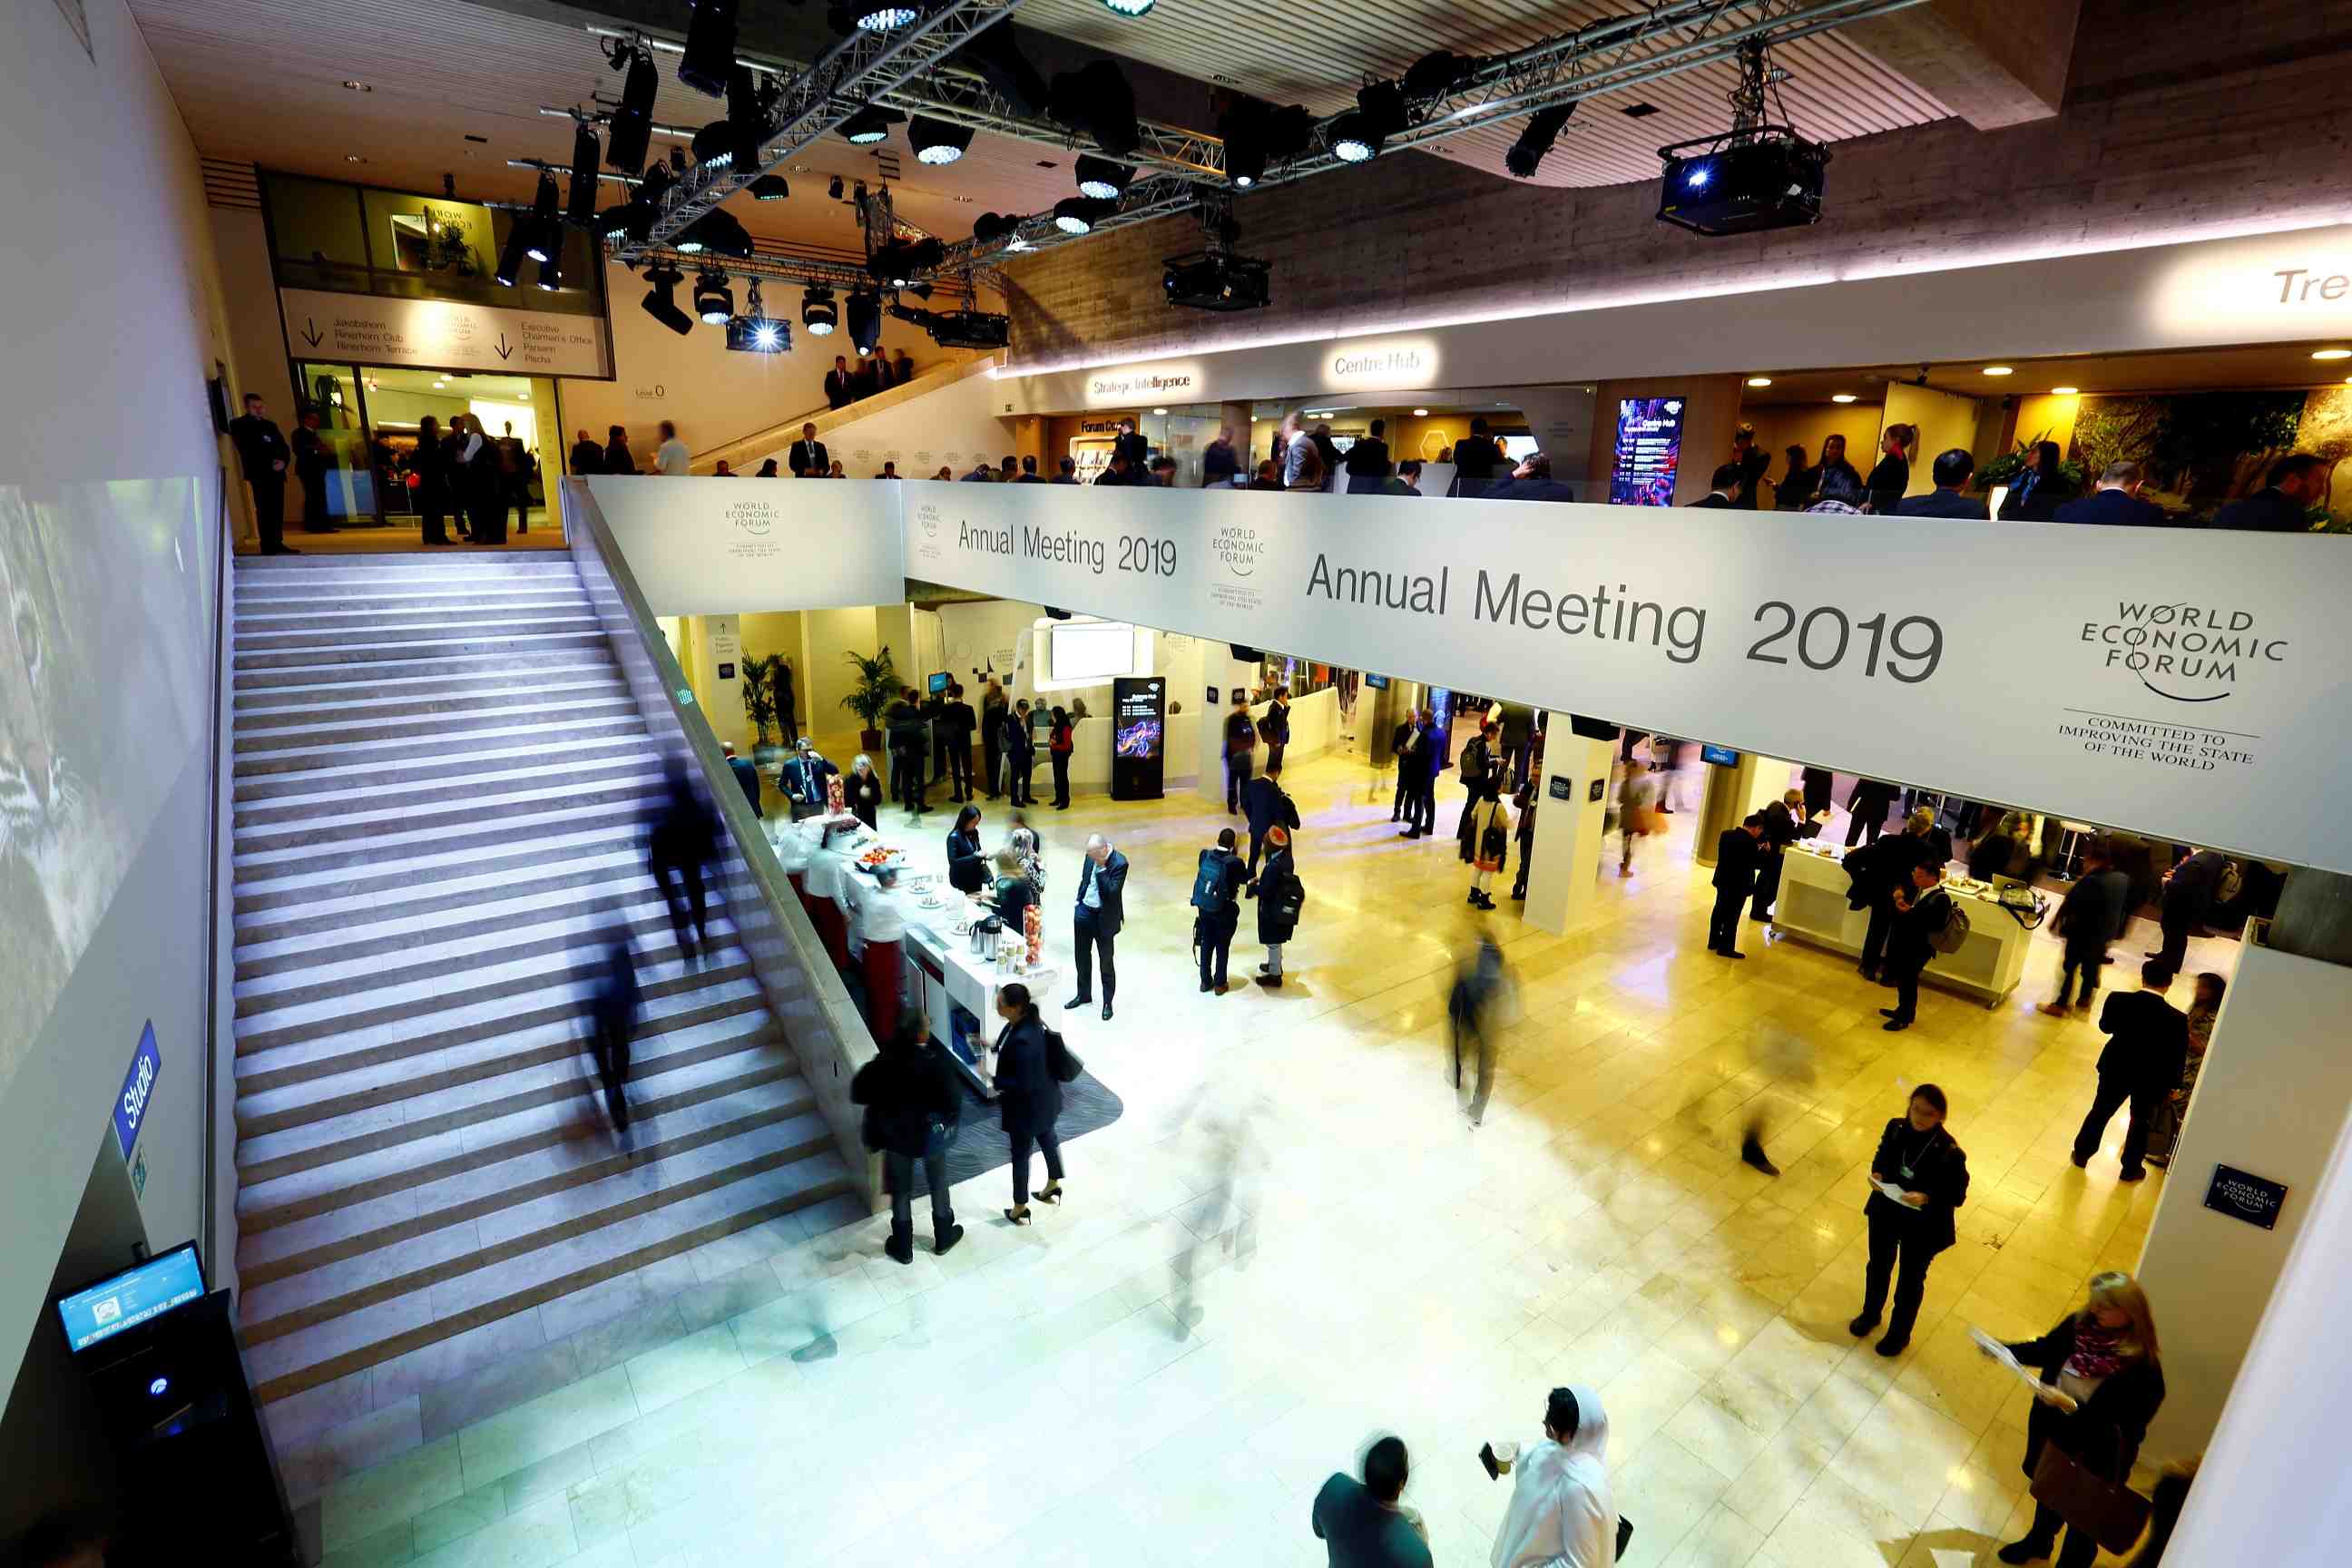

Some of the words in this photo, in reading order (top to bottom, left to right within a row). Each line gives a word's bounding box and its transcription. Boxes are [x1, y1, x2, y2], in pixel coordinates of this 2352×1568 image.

[2274, 269, 2350, 303] Tre
[521, 322, 559, 333] Executive
[569, 336, 593, 345] Office
[1335, 357, 1383, 375] Centre
[1387, 349, 1420, 371] Hub
[1135, 375, 1191, 391] Intelligence
[1082, 420, 1104, 433] Forum
[725, 510, 779, 518] ECONOMIC
[735, 518, 769, 527] FORUM
[1212, 538, 1264, 554] ECONOMIC
[1220, 527, 1256, 539] WORLD
[959, 520, 1014, 555] Annual
[1024, 525, 1104, 574] Meeting
[1118, 535, 1177, 576] 2019
[1220, 551, 1254, 565] FORUM
[1307, 553, 1449, 615] Annual
[1474, 569, 1707, 664] Meeting
[1747, 601, 1945, 684] 2019
[2119, 602, 2254, 632] WORLD
[2081, 622, 2288, 662] ECONOMIC
[2105, 649, 2236, 682] FORUM
[2088, 717, 2196, 742] COMMITTED
[2200, 733, 2226, 746] TO
[2058, 725, 2153, 750] IMPROVING
[2158, 740, 2194, 756] THE
[2199, 747, 2254, 765] STATE
[2084, 741, 2108, 753] OF
[2112, 745, 2144, 760] THE
[2151, 752, 2215, 771] WORLD
[123, 1054, 153, 1130] Studio
[2217, 1181, 2278, 1208] ECONOMIC
[2223, 1191, 2264, 1210] FORUM
[2228, 1179, 2268, 1198] WORLD
